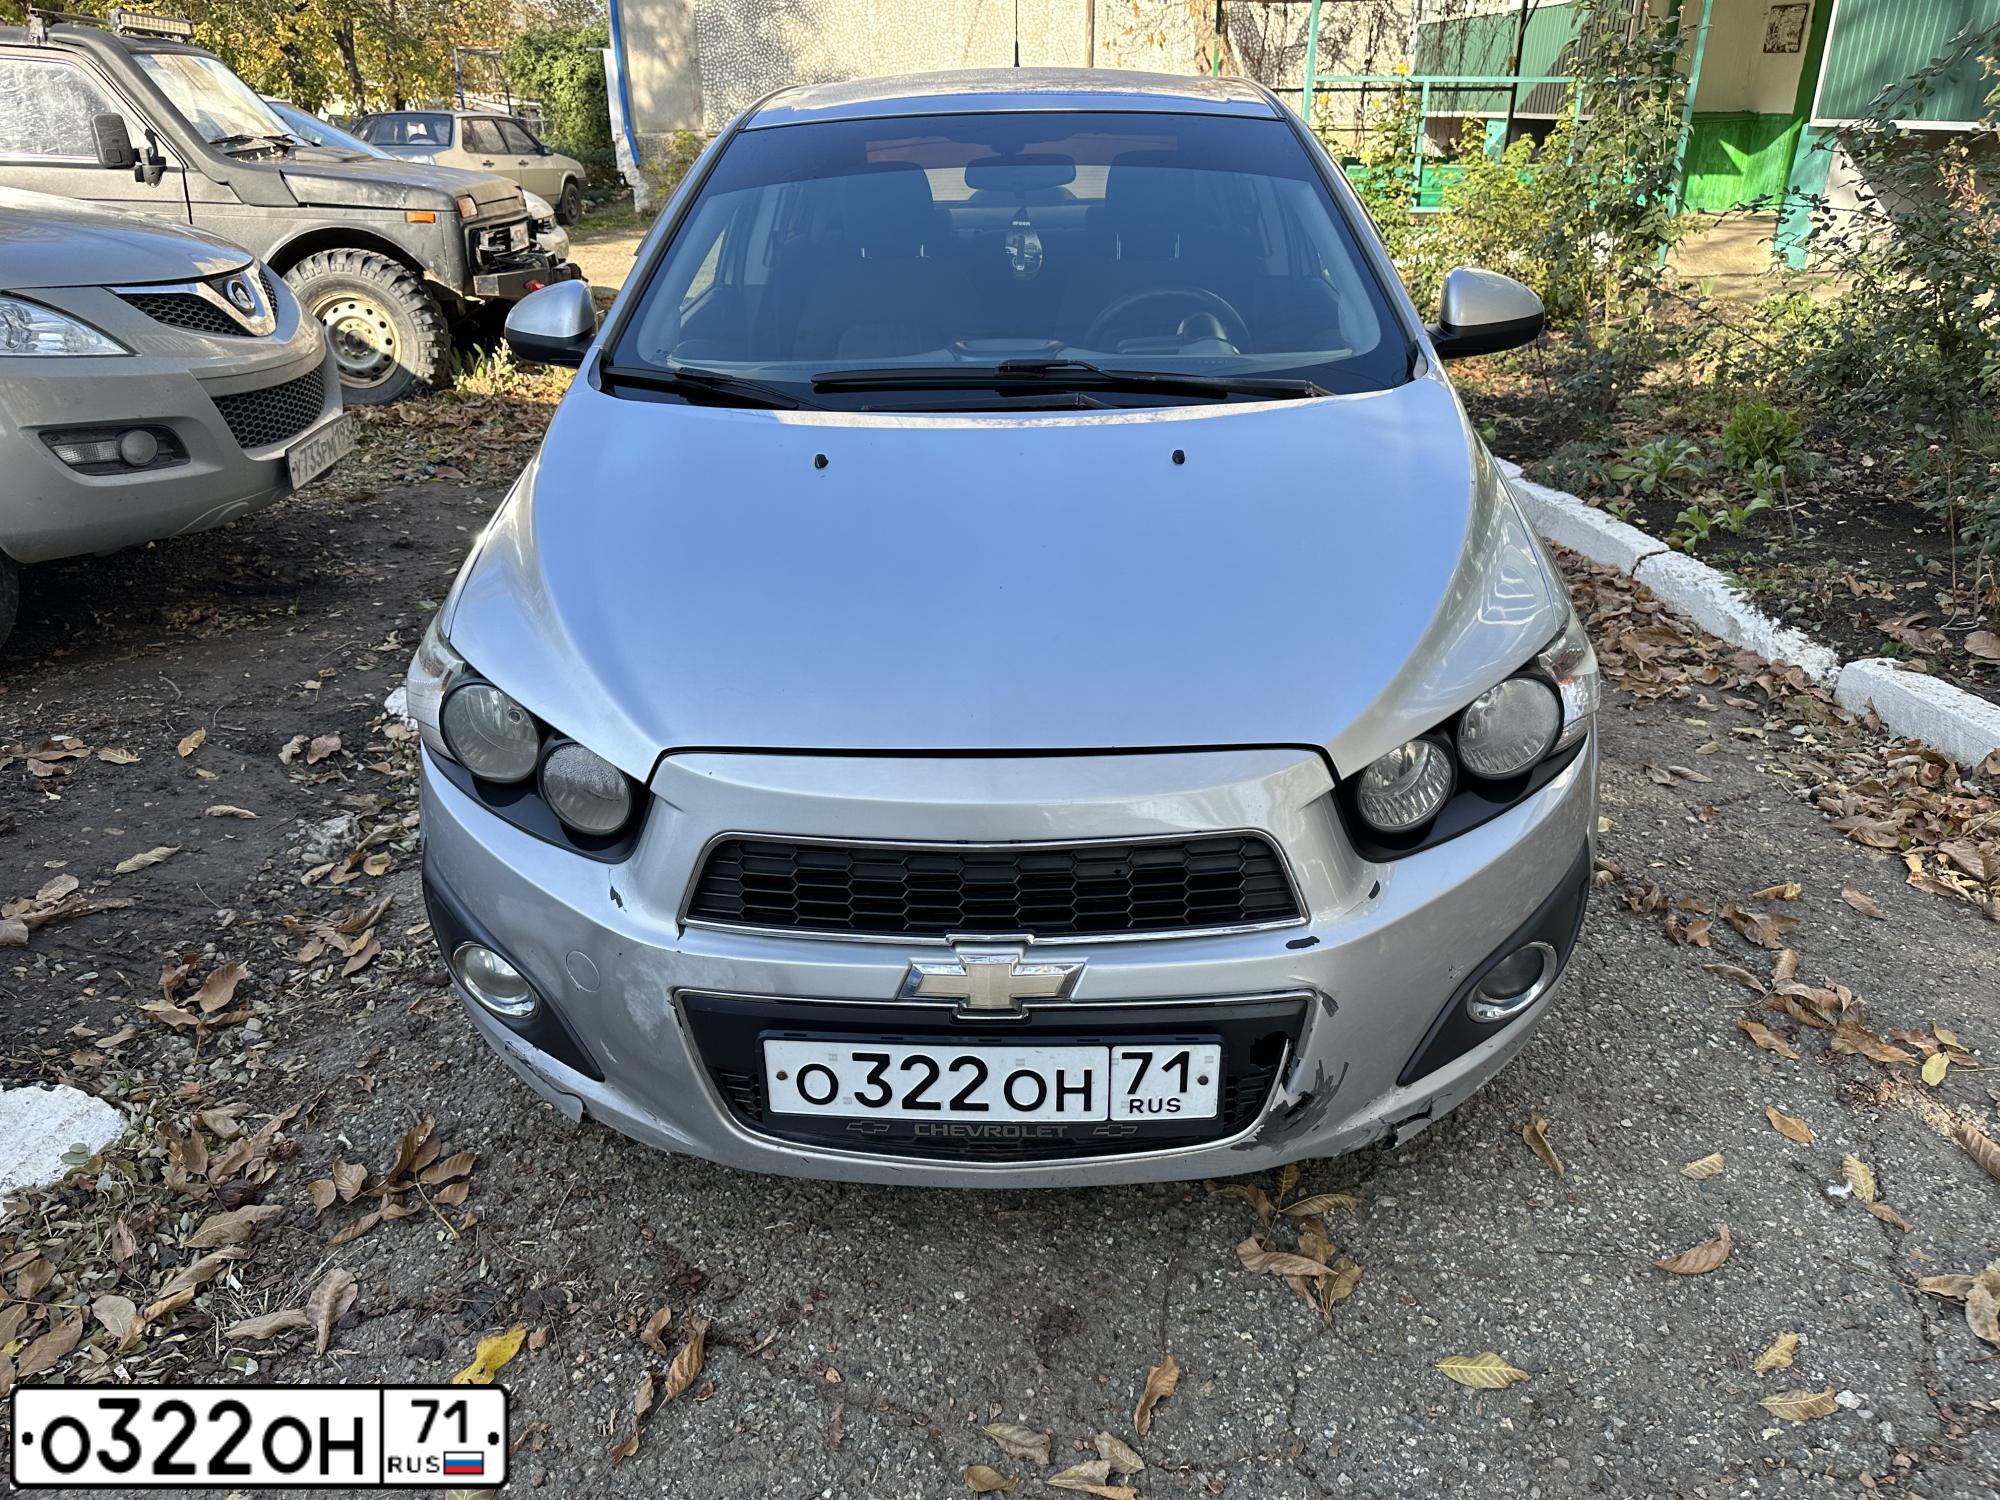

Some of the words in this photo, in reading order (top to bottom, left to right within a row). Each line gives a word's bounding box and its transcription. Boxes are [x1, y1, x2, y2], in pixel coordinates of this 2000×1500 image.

[1122, 1051, 1189, 1094] 71
[1129, 1098, 1181, 1113] RUS
[914, 1124, 1068, 1137] CHEVROLET
